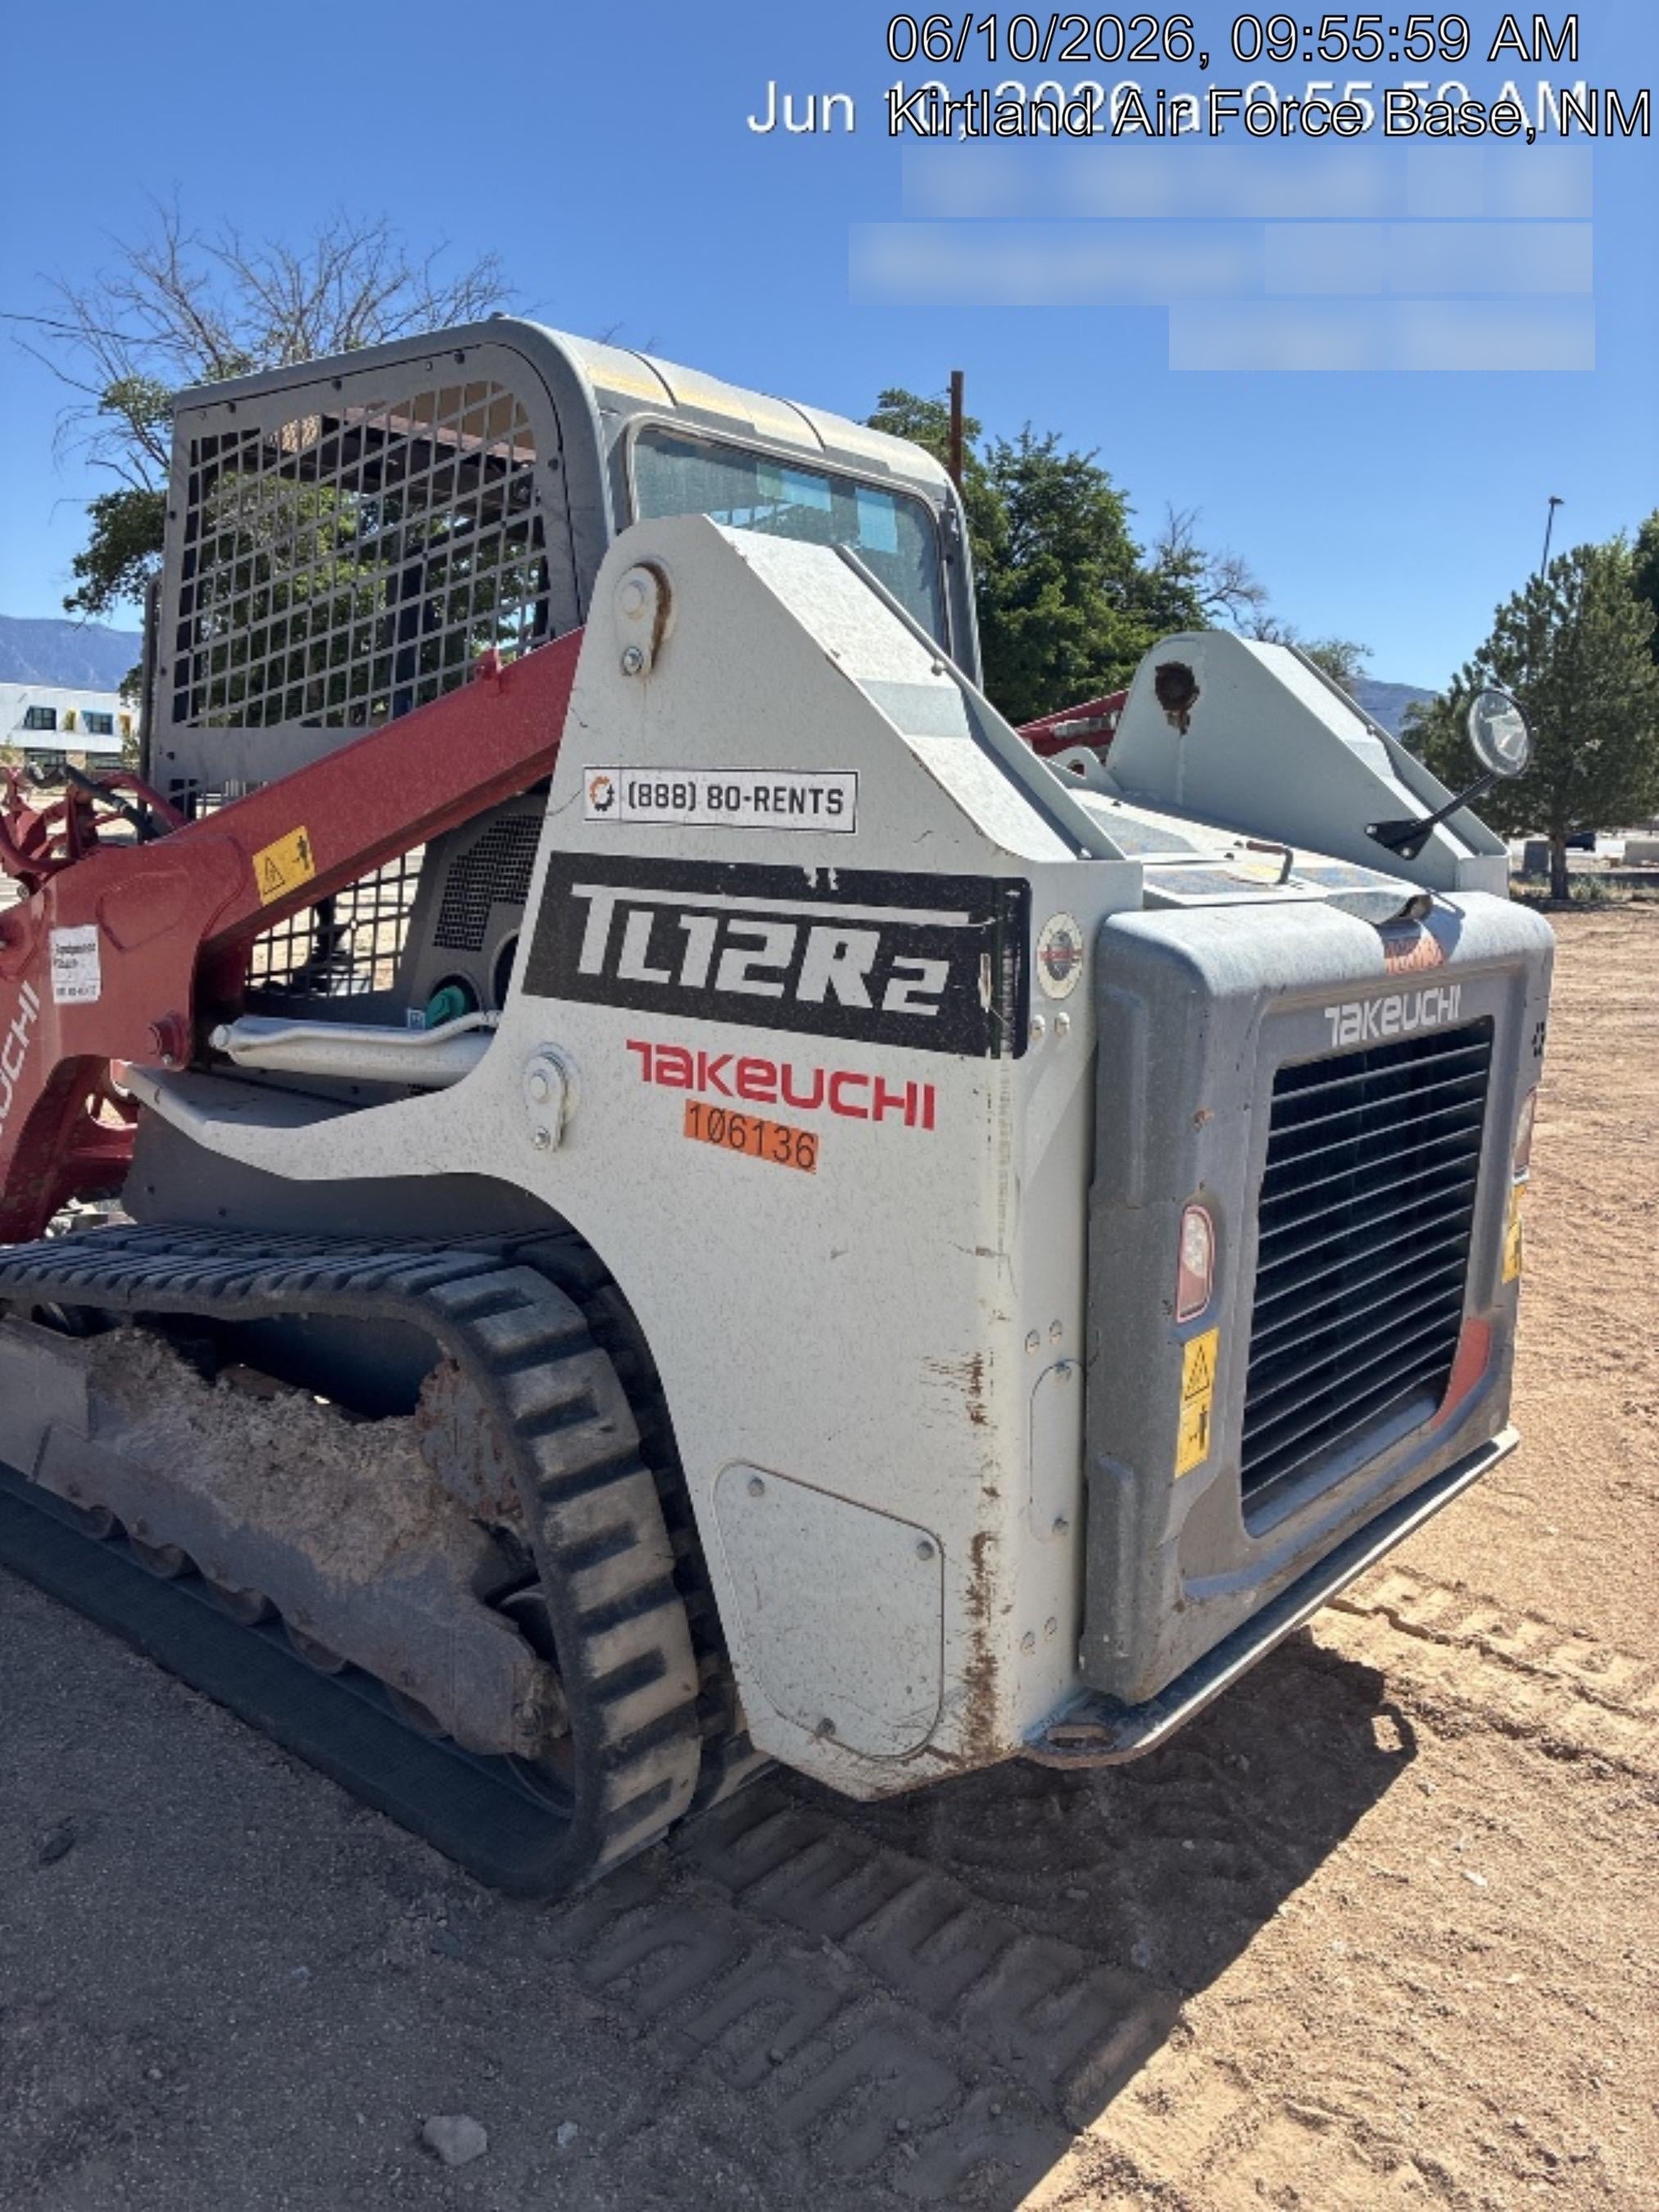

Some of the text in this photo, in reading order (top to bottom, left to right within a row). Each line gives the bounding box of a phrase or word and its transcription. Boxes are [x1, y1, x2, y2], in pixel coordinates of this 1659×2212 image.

[628, 781, 844, 814] (888) 80-RENTS
[571, 882, 971, 1017] TL12R2
[689, 1103, 815, 1169] 106136
